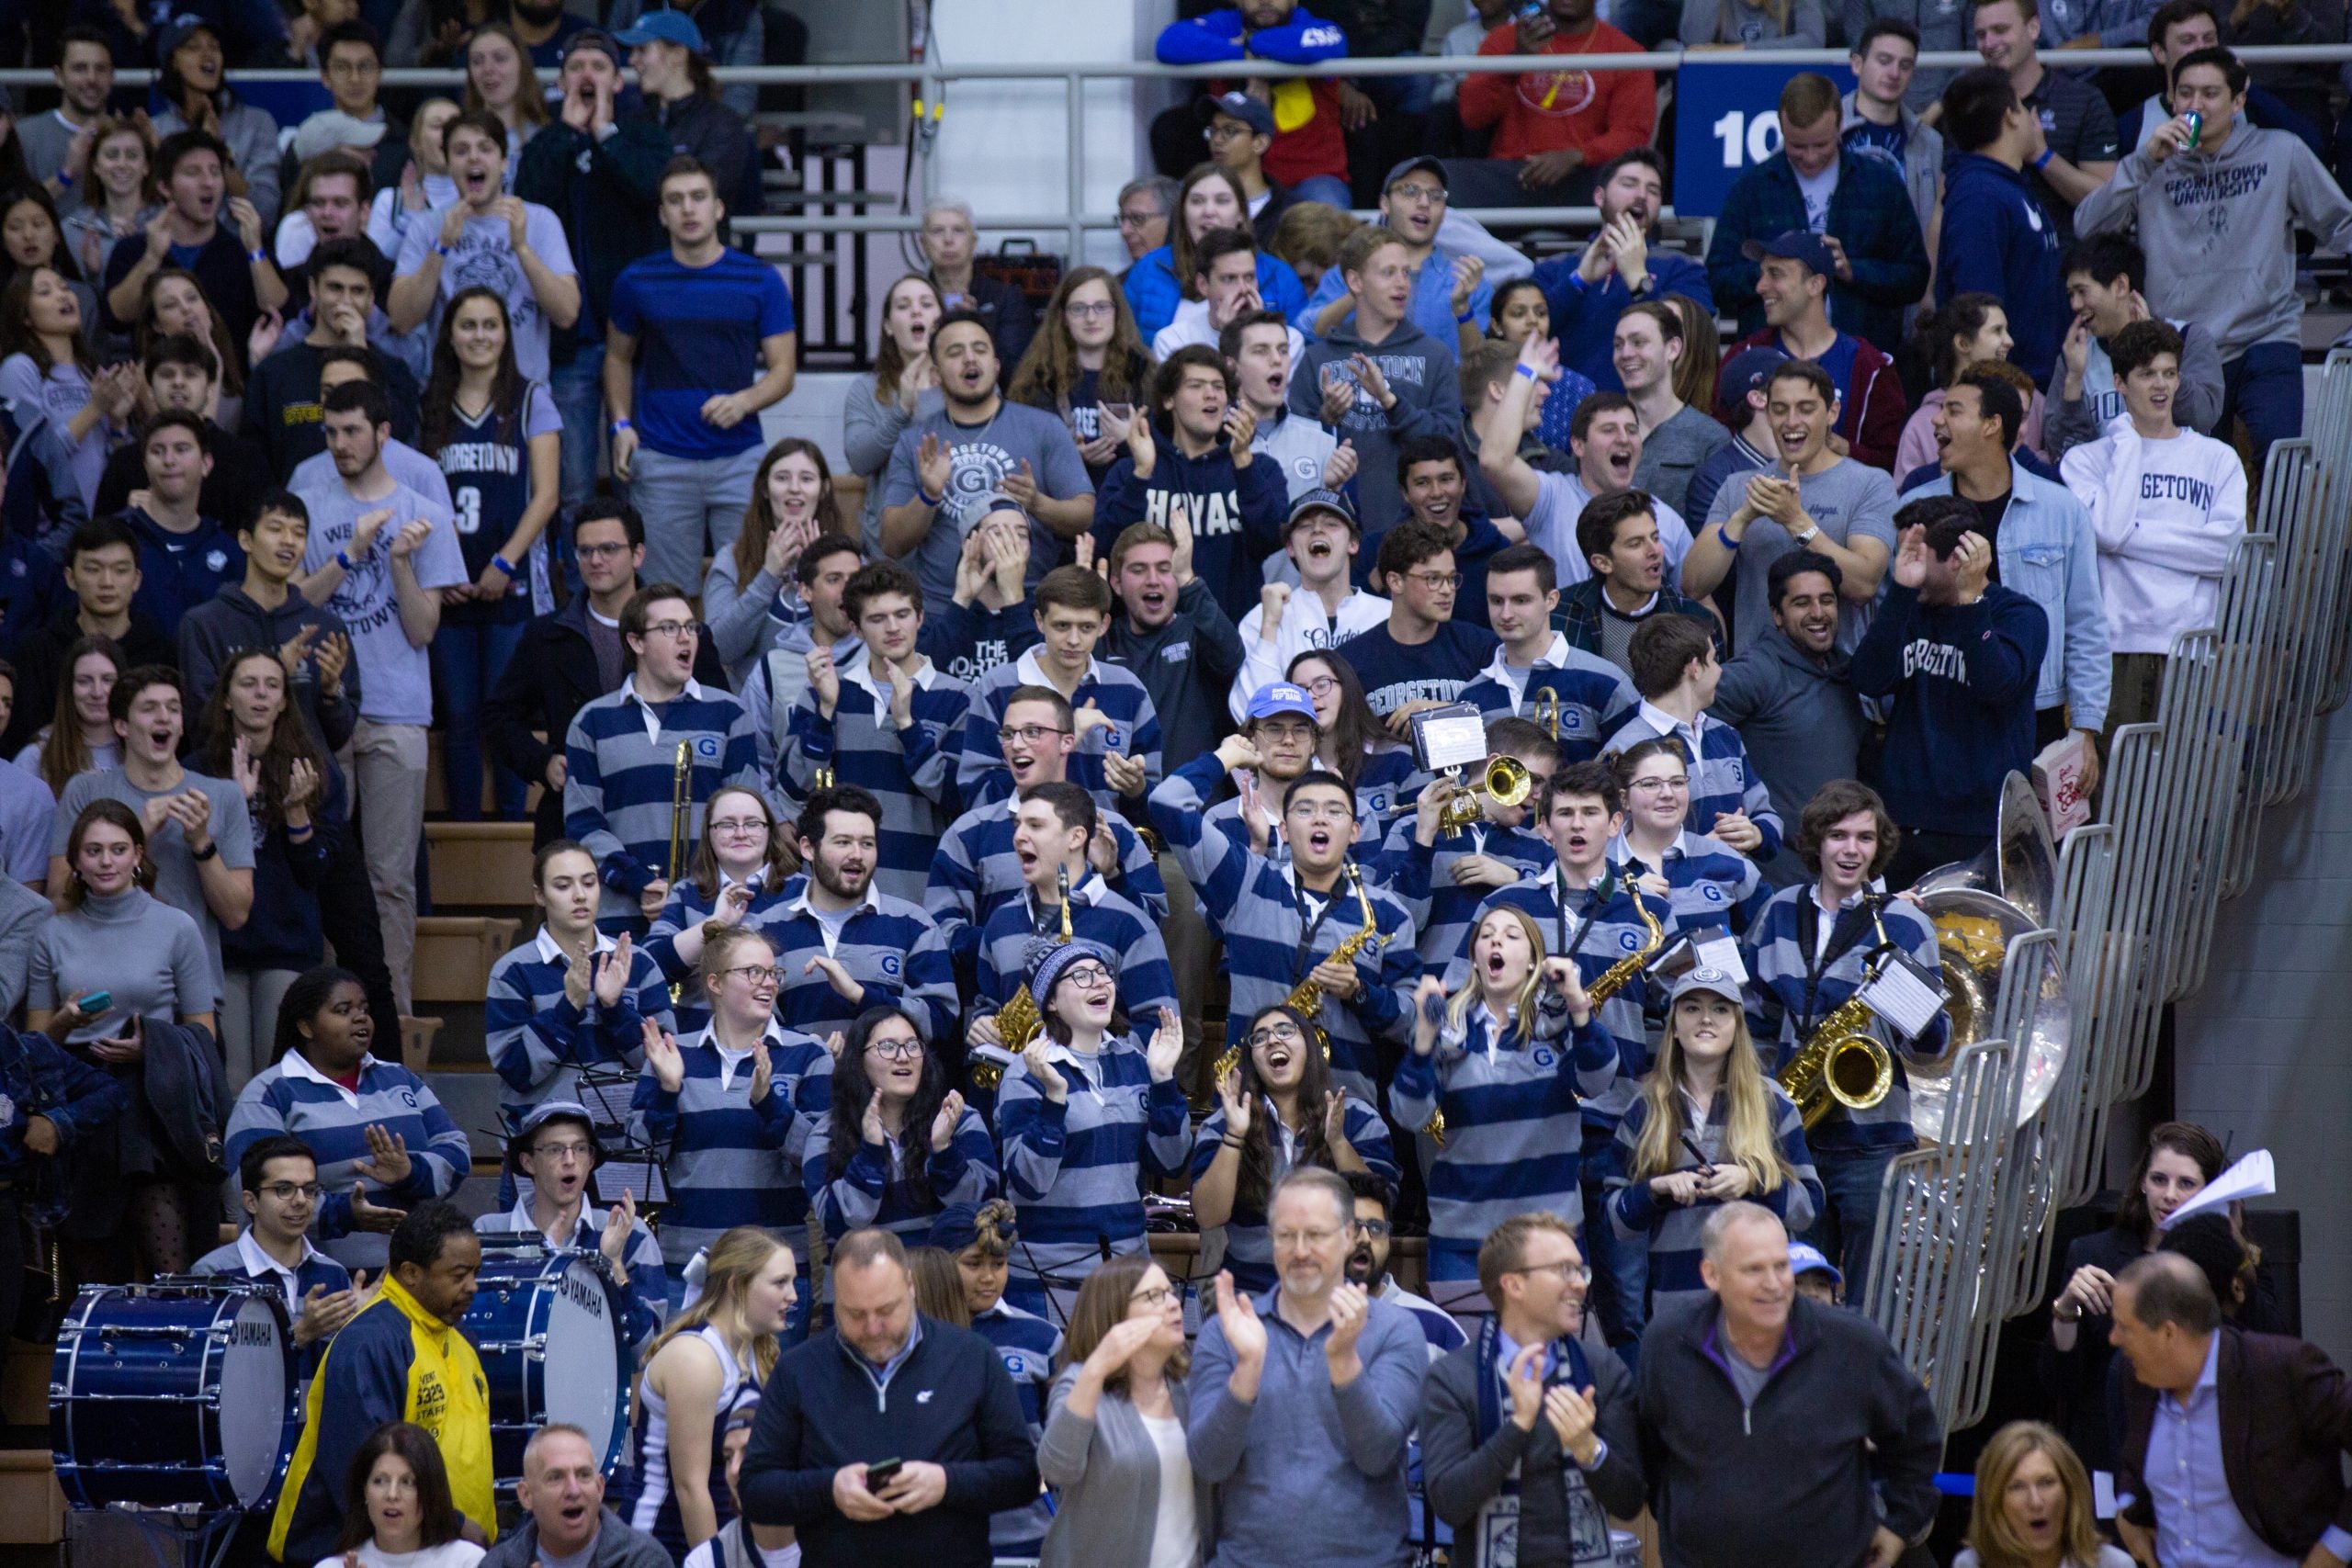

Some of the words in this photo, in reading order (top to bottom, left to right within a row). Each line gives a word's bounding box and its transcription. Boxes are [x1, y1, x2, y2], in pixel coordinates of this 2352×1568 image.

[1294, 456, 1318, 480] G
[456, 486, 481, 534] 3
[975, 639, 1008, 658] THE
[1562, 710, 1580, 728] G
[1105, 728, 1121, 746] G
[698, 739, 717, 756] G
[1369, 794, 1386, 811] G
[1702, 886, 1722, 901] G
[1619, 932, 1637, 952] G
[881, 955, 899, 975] G
[1533, 1049, 1554, 1066] G
[772, 1081, 789, 1100] G
[401, 1092, 416, 1108] G
[570, 1277, 602, 1320] YAMAHA
[240, 1322, 271, 1348] YAMAHA
[1003, 1355, 1024, 1373] G
